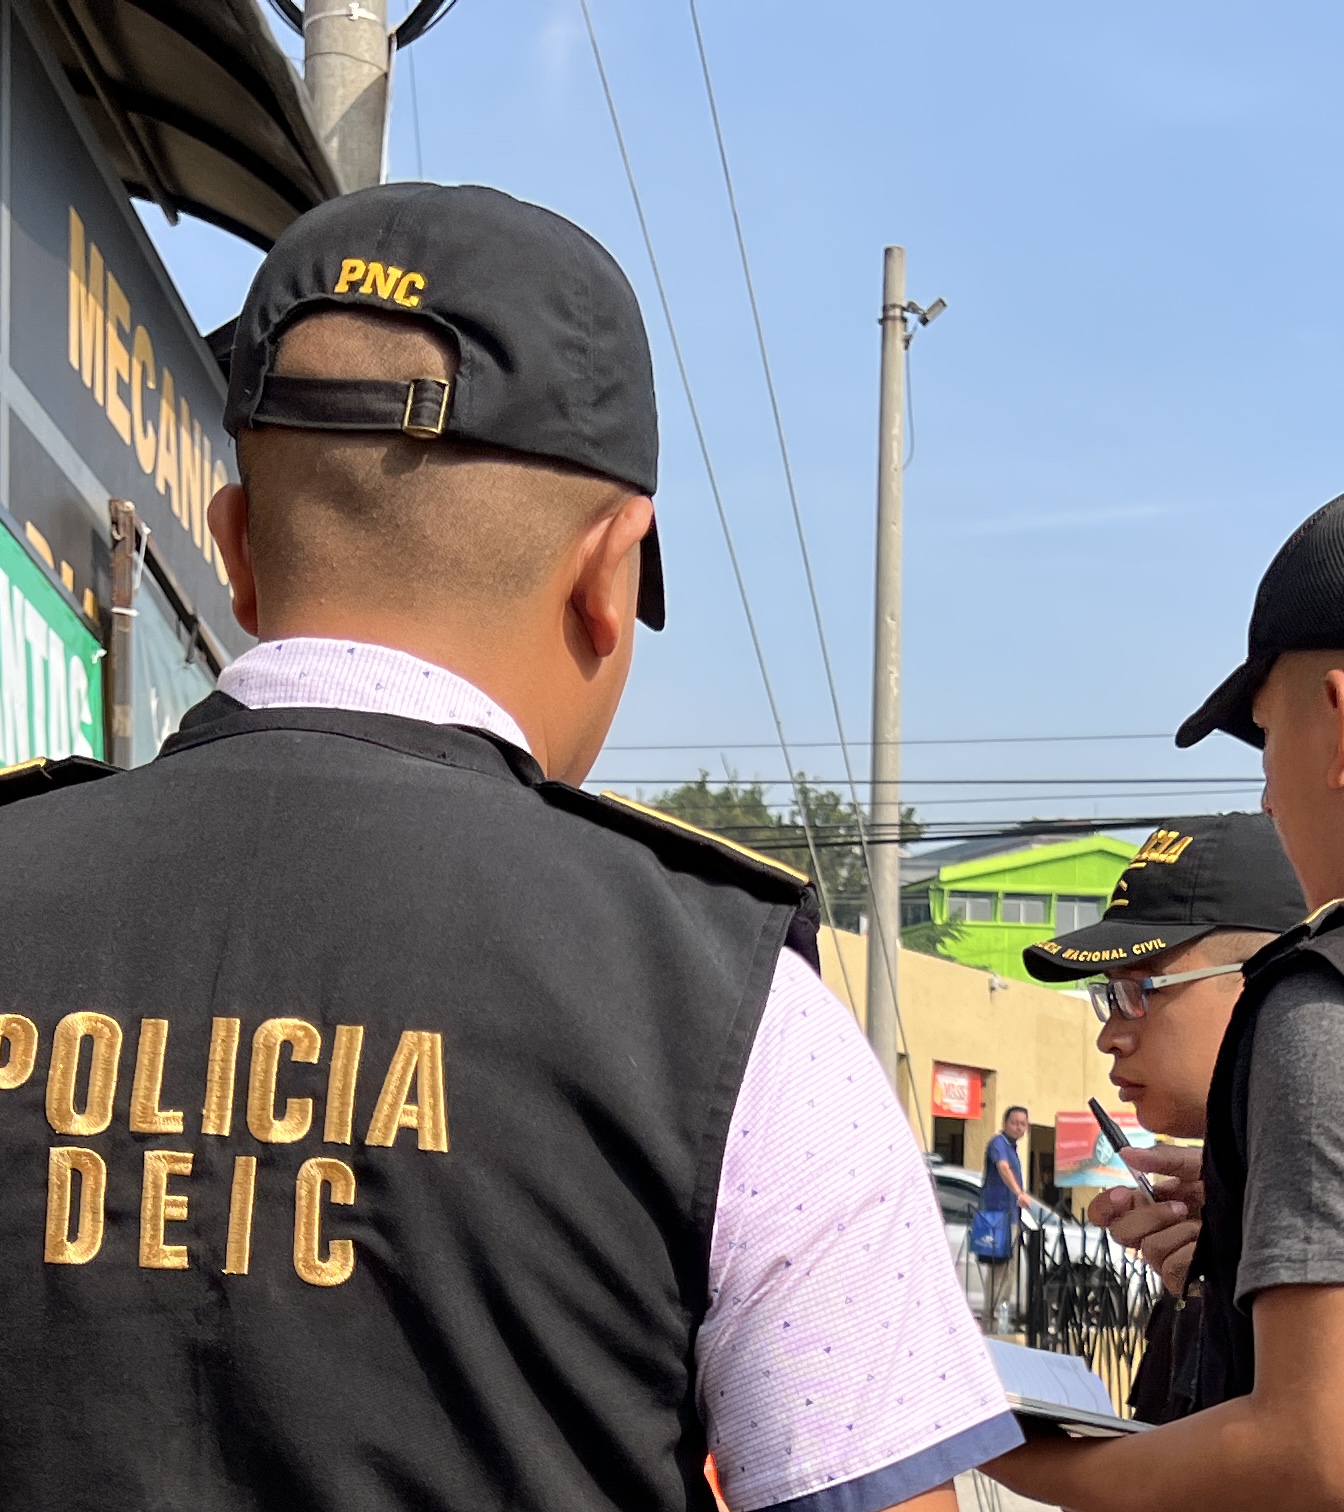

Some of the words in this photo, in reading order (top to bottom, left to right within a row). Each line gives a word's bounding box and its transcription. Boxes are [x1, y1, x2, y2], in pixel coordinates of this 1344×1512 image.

[334, 259, 425, 307] PNC
[1062, 948, 1127, 962] NACIONAL
[1132, 938, 1166, 955] CIVIL
[44, 1146, 355, 1286] DEIC
